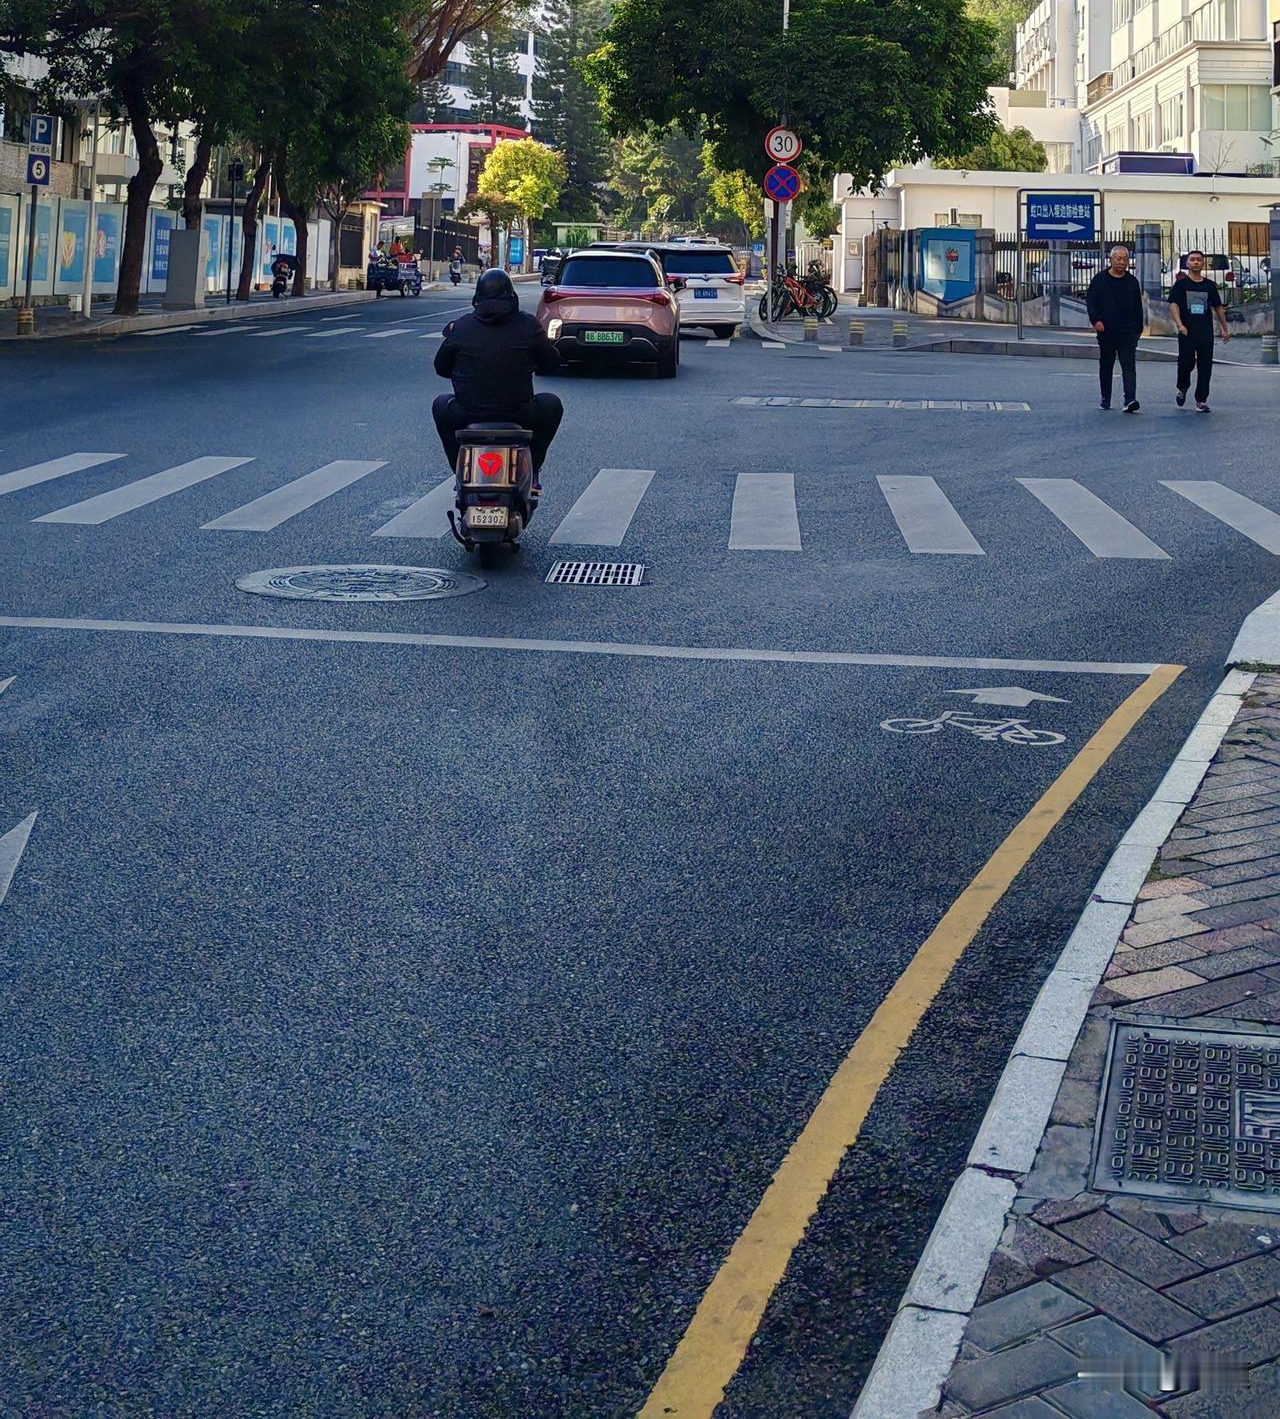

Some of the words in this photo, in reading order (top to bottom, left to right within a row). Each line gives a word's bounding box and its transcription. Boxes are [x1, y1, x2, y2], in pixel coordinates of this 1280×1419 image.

[35, 119, 48, 140] P
[774, 135, 793, 153] 30
[36, 163, 43, 176] 5
